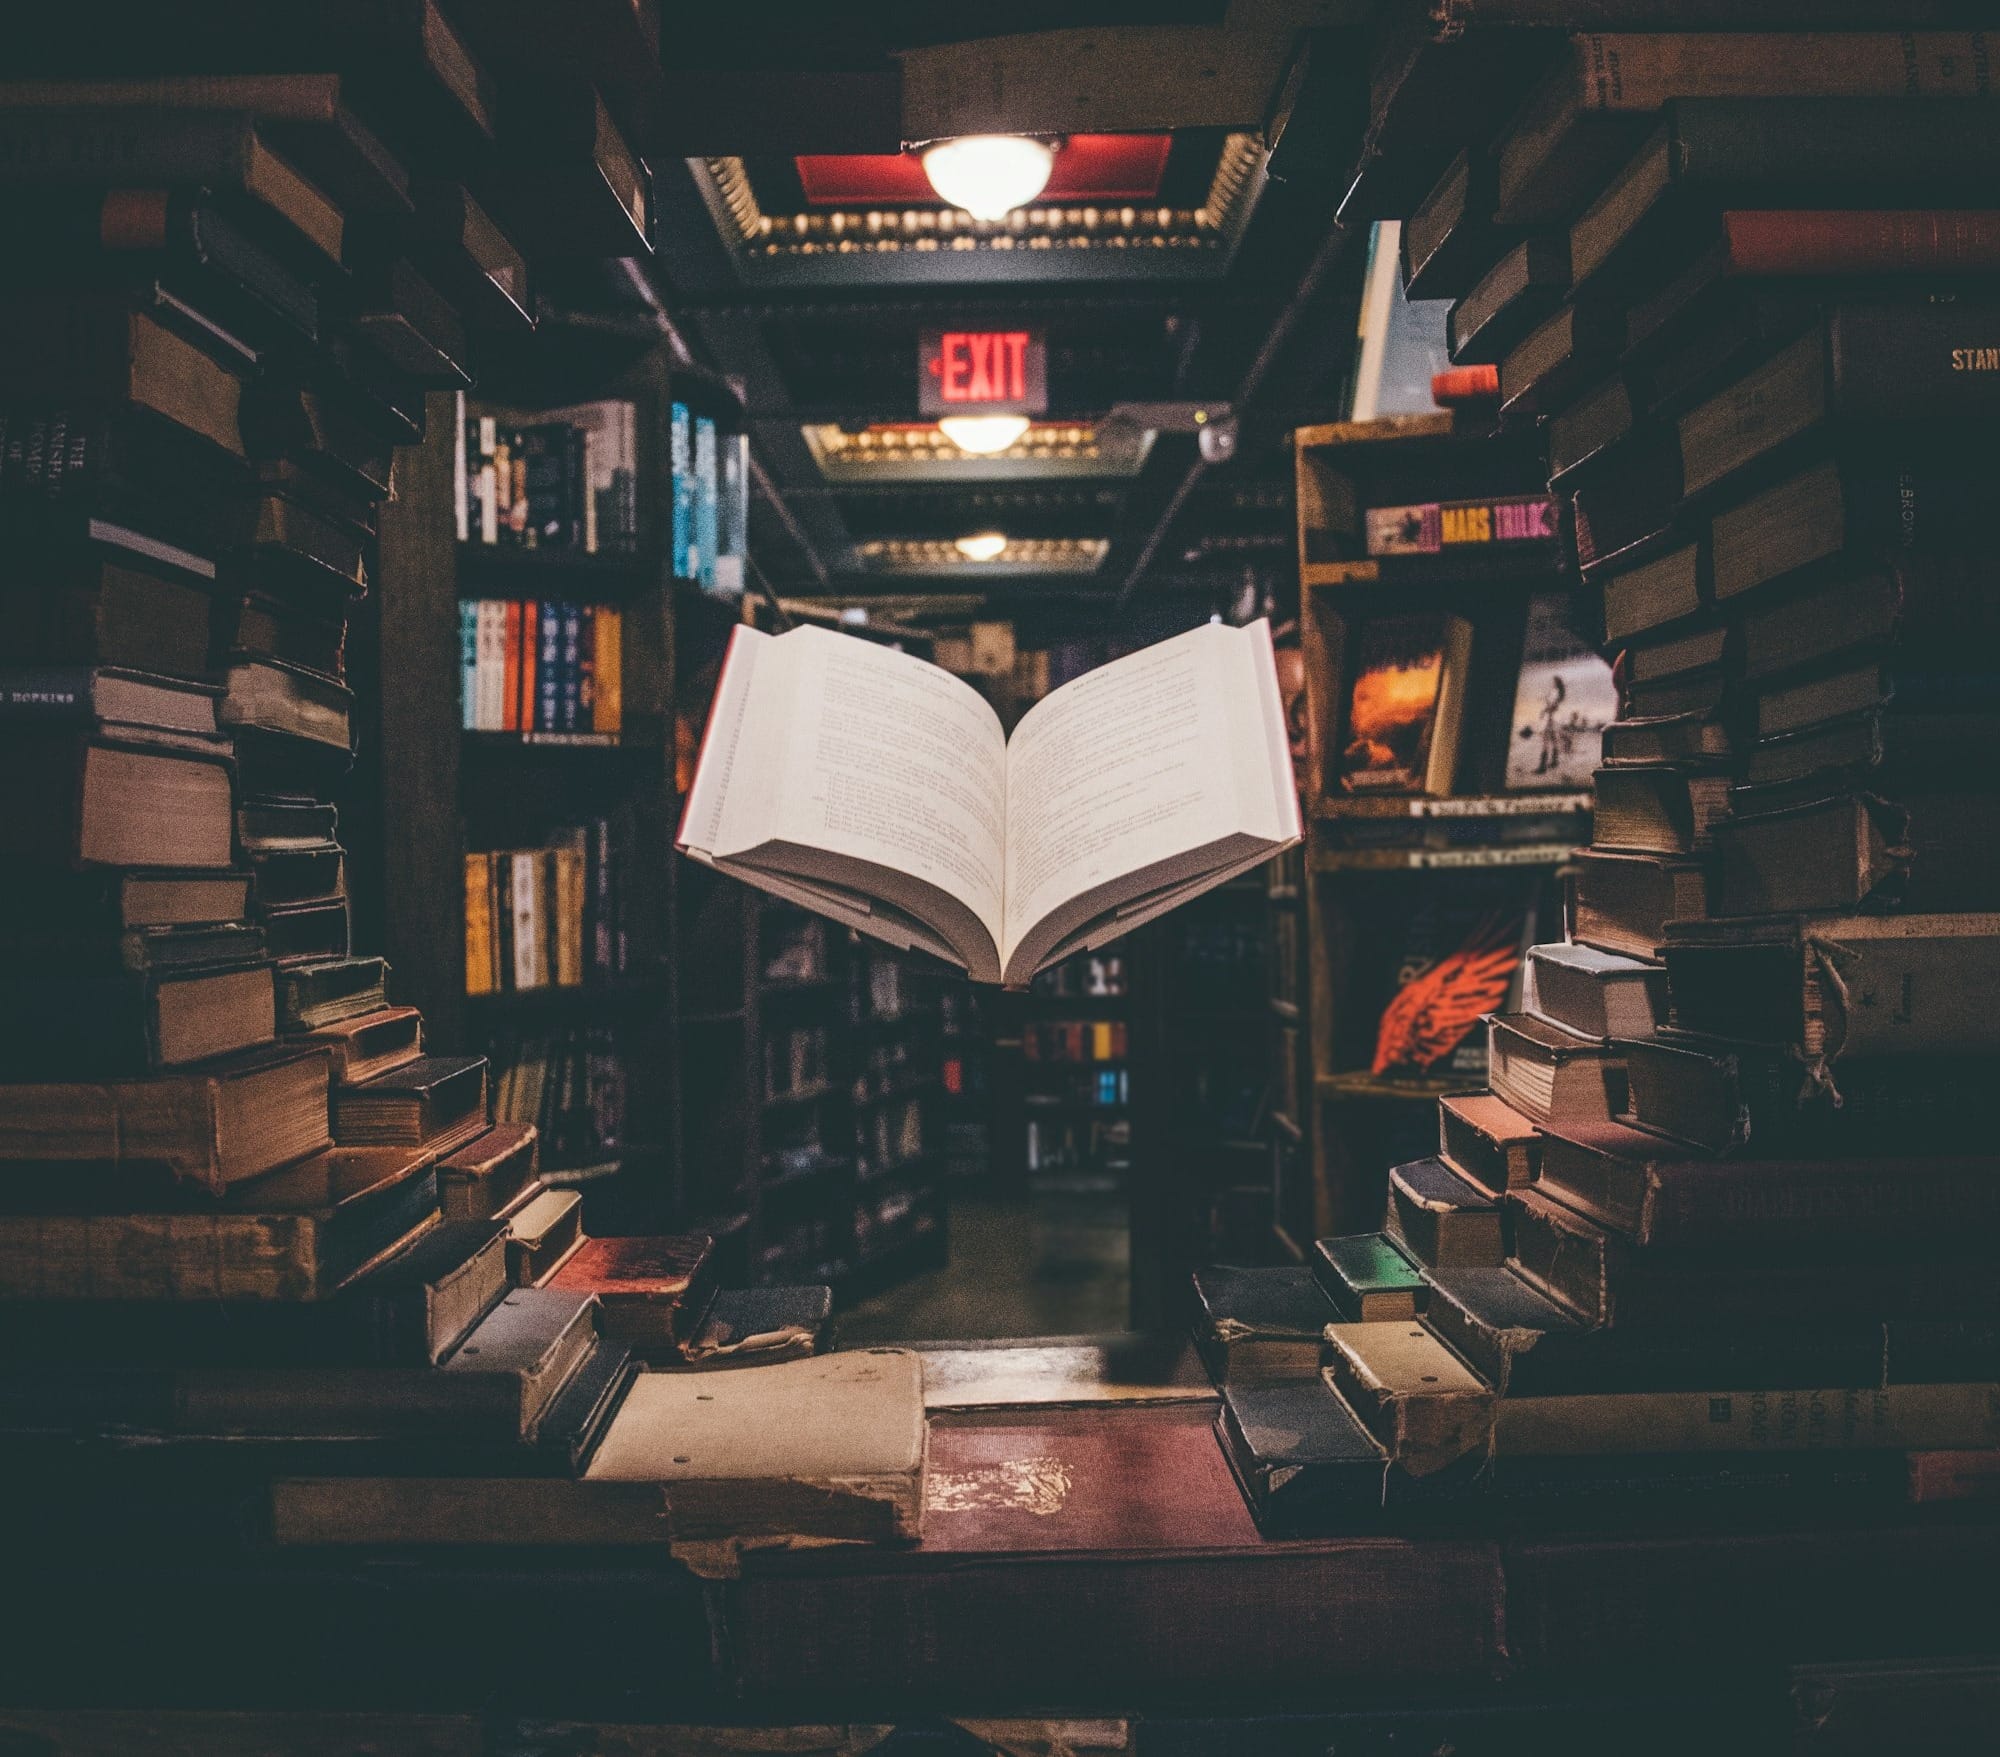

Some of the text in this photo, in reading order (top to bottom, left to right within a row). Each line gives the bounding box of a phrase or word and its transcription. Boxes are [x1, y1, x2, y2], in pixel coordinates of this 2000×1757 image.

[941, 331, 1029, 401] EXIT
[1951, 348, 2000, 371] STAN
[1442, 507, 1490, 543] MARS
